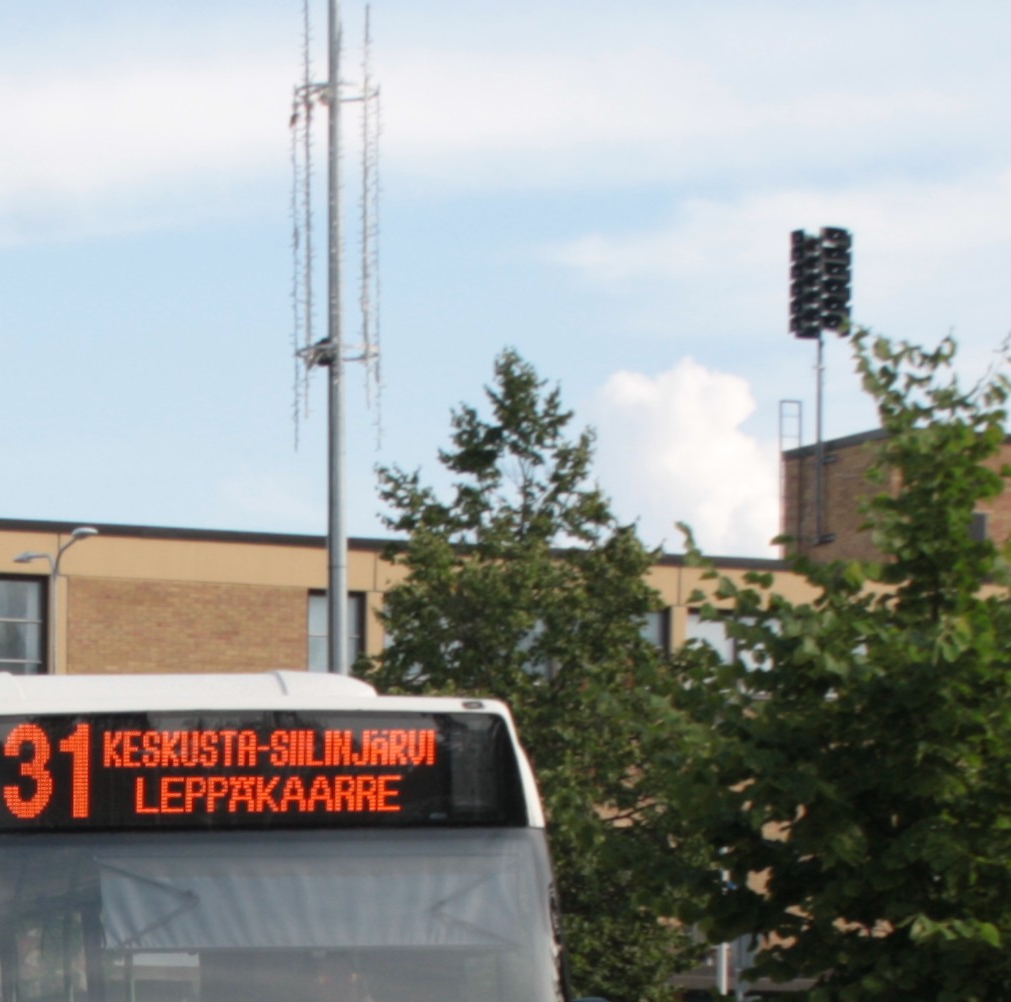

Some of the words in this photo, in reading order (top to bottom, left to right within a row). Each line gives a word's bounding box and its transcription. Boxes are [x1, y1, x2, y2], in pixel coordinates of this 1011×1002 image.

[103, 730, 436, 767] KESKUSTA-SIILINJÄRVI
[3, 723, 90, 819] 31
[135, 775, 402, 813] LEPPÄKAARRE
